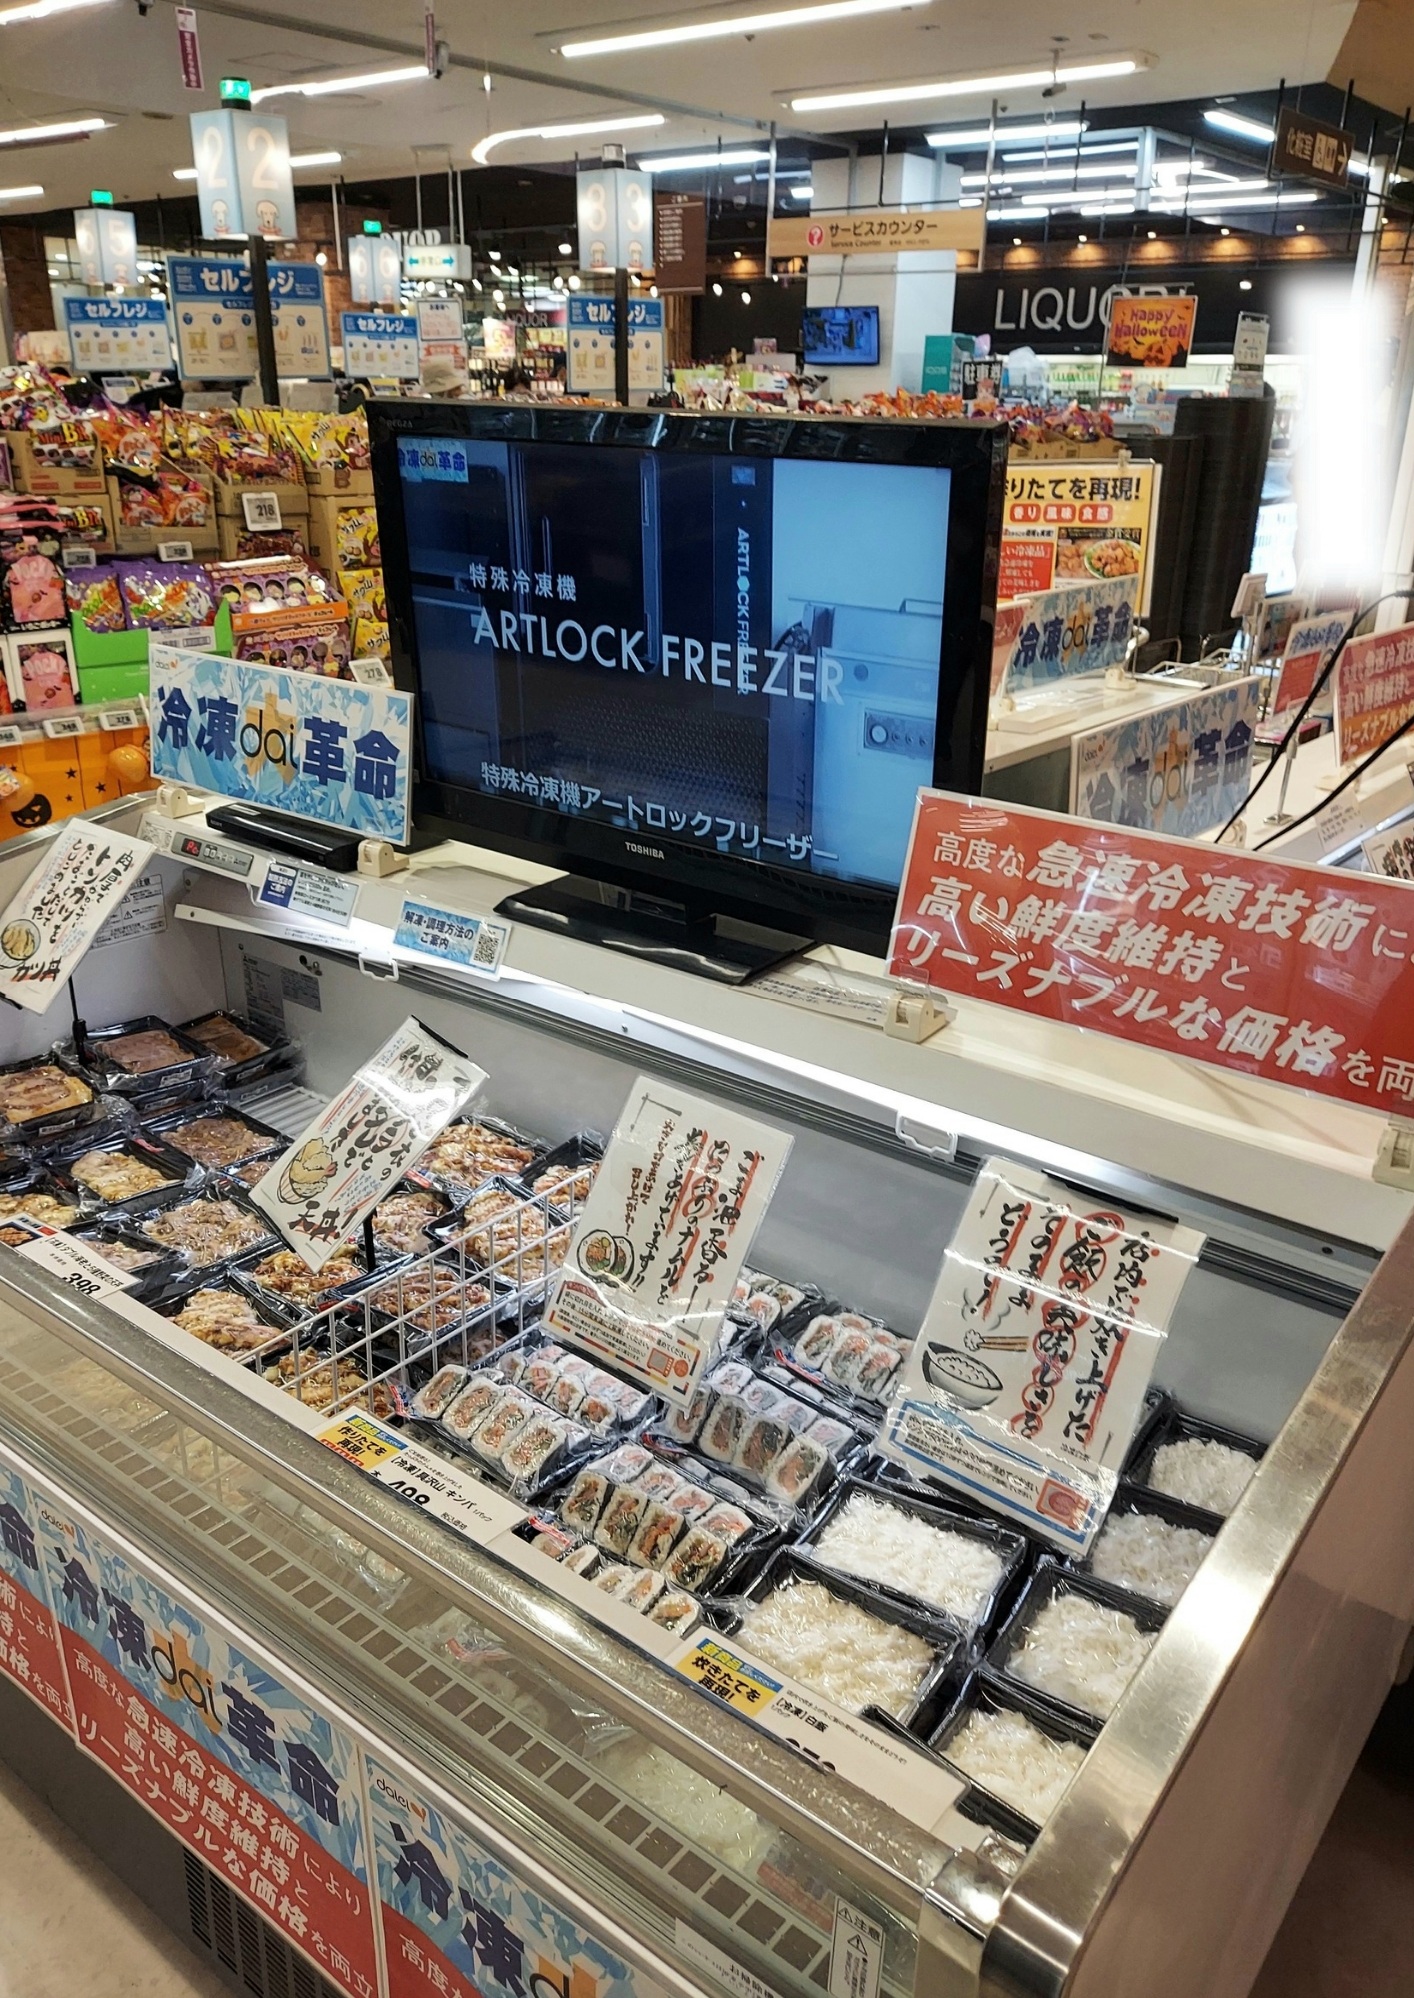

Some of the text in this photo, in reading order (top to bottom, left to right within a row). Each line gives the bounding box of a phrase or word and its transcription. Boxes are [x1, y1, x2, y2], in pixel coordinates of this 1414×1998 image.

[203, 126, 228, 189] 2
[247, 127, 279, 190] 2
[829, 219, 938, 238] サービスカウンター
[85, 302, 148, 318] セルフレジ
[357, 317, 404, 333] セルフレジ
[586, 302, 646, 324] セルジ
[1004, 477, 1142, 502] りたてを再現!
[256, 503, 276, 517] 218
[1013, 506, 1038, 520] 香り
[468, 562, 577, 602] 特殊冷凍機
[1014, 601, 1132, 668] 冷凍dai革命
[474, 607, 845, 705] ARTLOCK FREEZER
[364, 667, 383, 680] 278
[157, 686, 401, 800] 冷凍dai革命
[1085, 719, 1252, 830] 冷凍dai革命
[481, 762, 840, 862] 特殊冷凍機アートロックフリーザー
[624, 840, 666, 861] TOSHIBA
[933, 830, 1414, 968] 高度な急速冷凍技術に
[403, 910, 475, 941] 解凍・調理方法の
[420, 931, 450, 950] ご案内
[916, 875, 1252, 993] 高い鮮度維持と
[63, 1271, 102, 1296] 398
[336, 1437, 367, 1458] 再現!
[337, 1425, 388, 1458] 作りたてを
[445, 1488, 478, 1511] キンパ
[0, 1502, 39, 1571] 命
[440, 1510, 468, 1532] 税込価格
[701, 1641, 744, 1672] 新商品
[53, 1547, 341, 1827] 冷凍dai革命
[690, 1655, 762, 1704] 炊きたてを
[697, 1677, 736, 1703] 再現!
[72, 1647, 363, 1917] 高度な急速冷凍技術により
[123, 1721, 309, 1906] 高い鮮度維持と
[80, 1712, 376, 1998] リーズナブルな価格を両立
[853, 1916, 882, 1942] 注意
